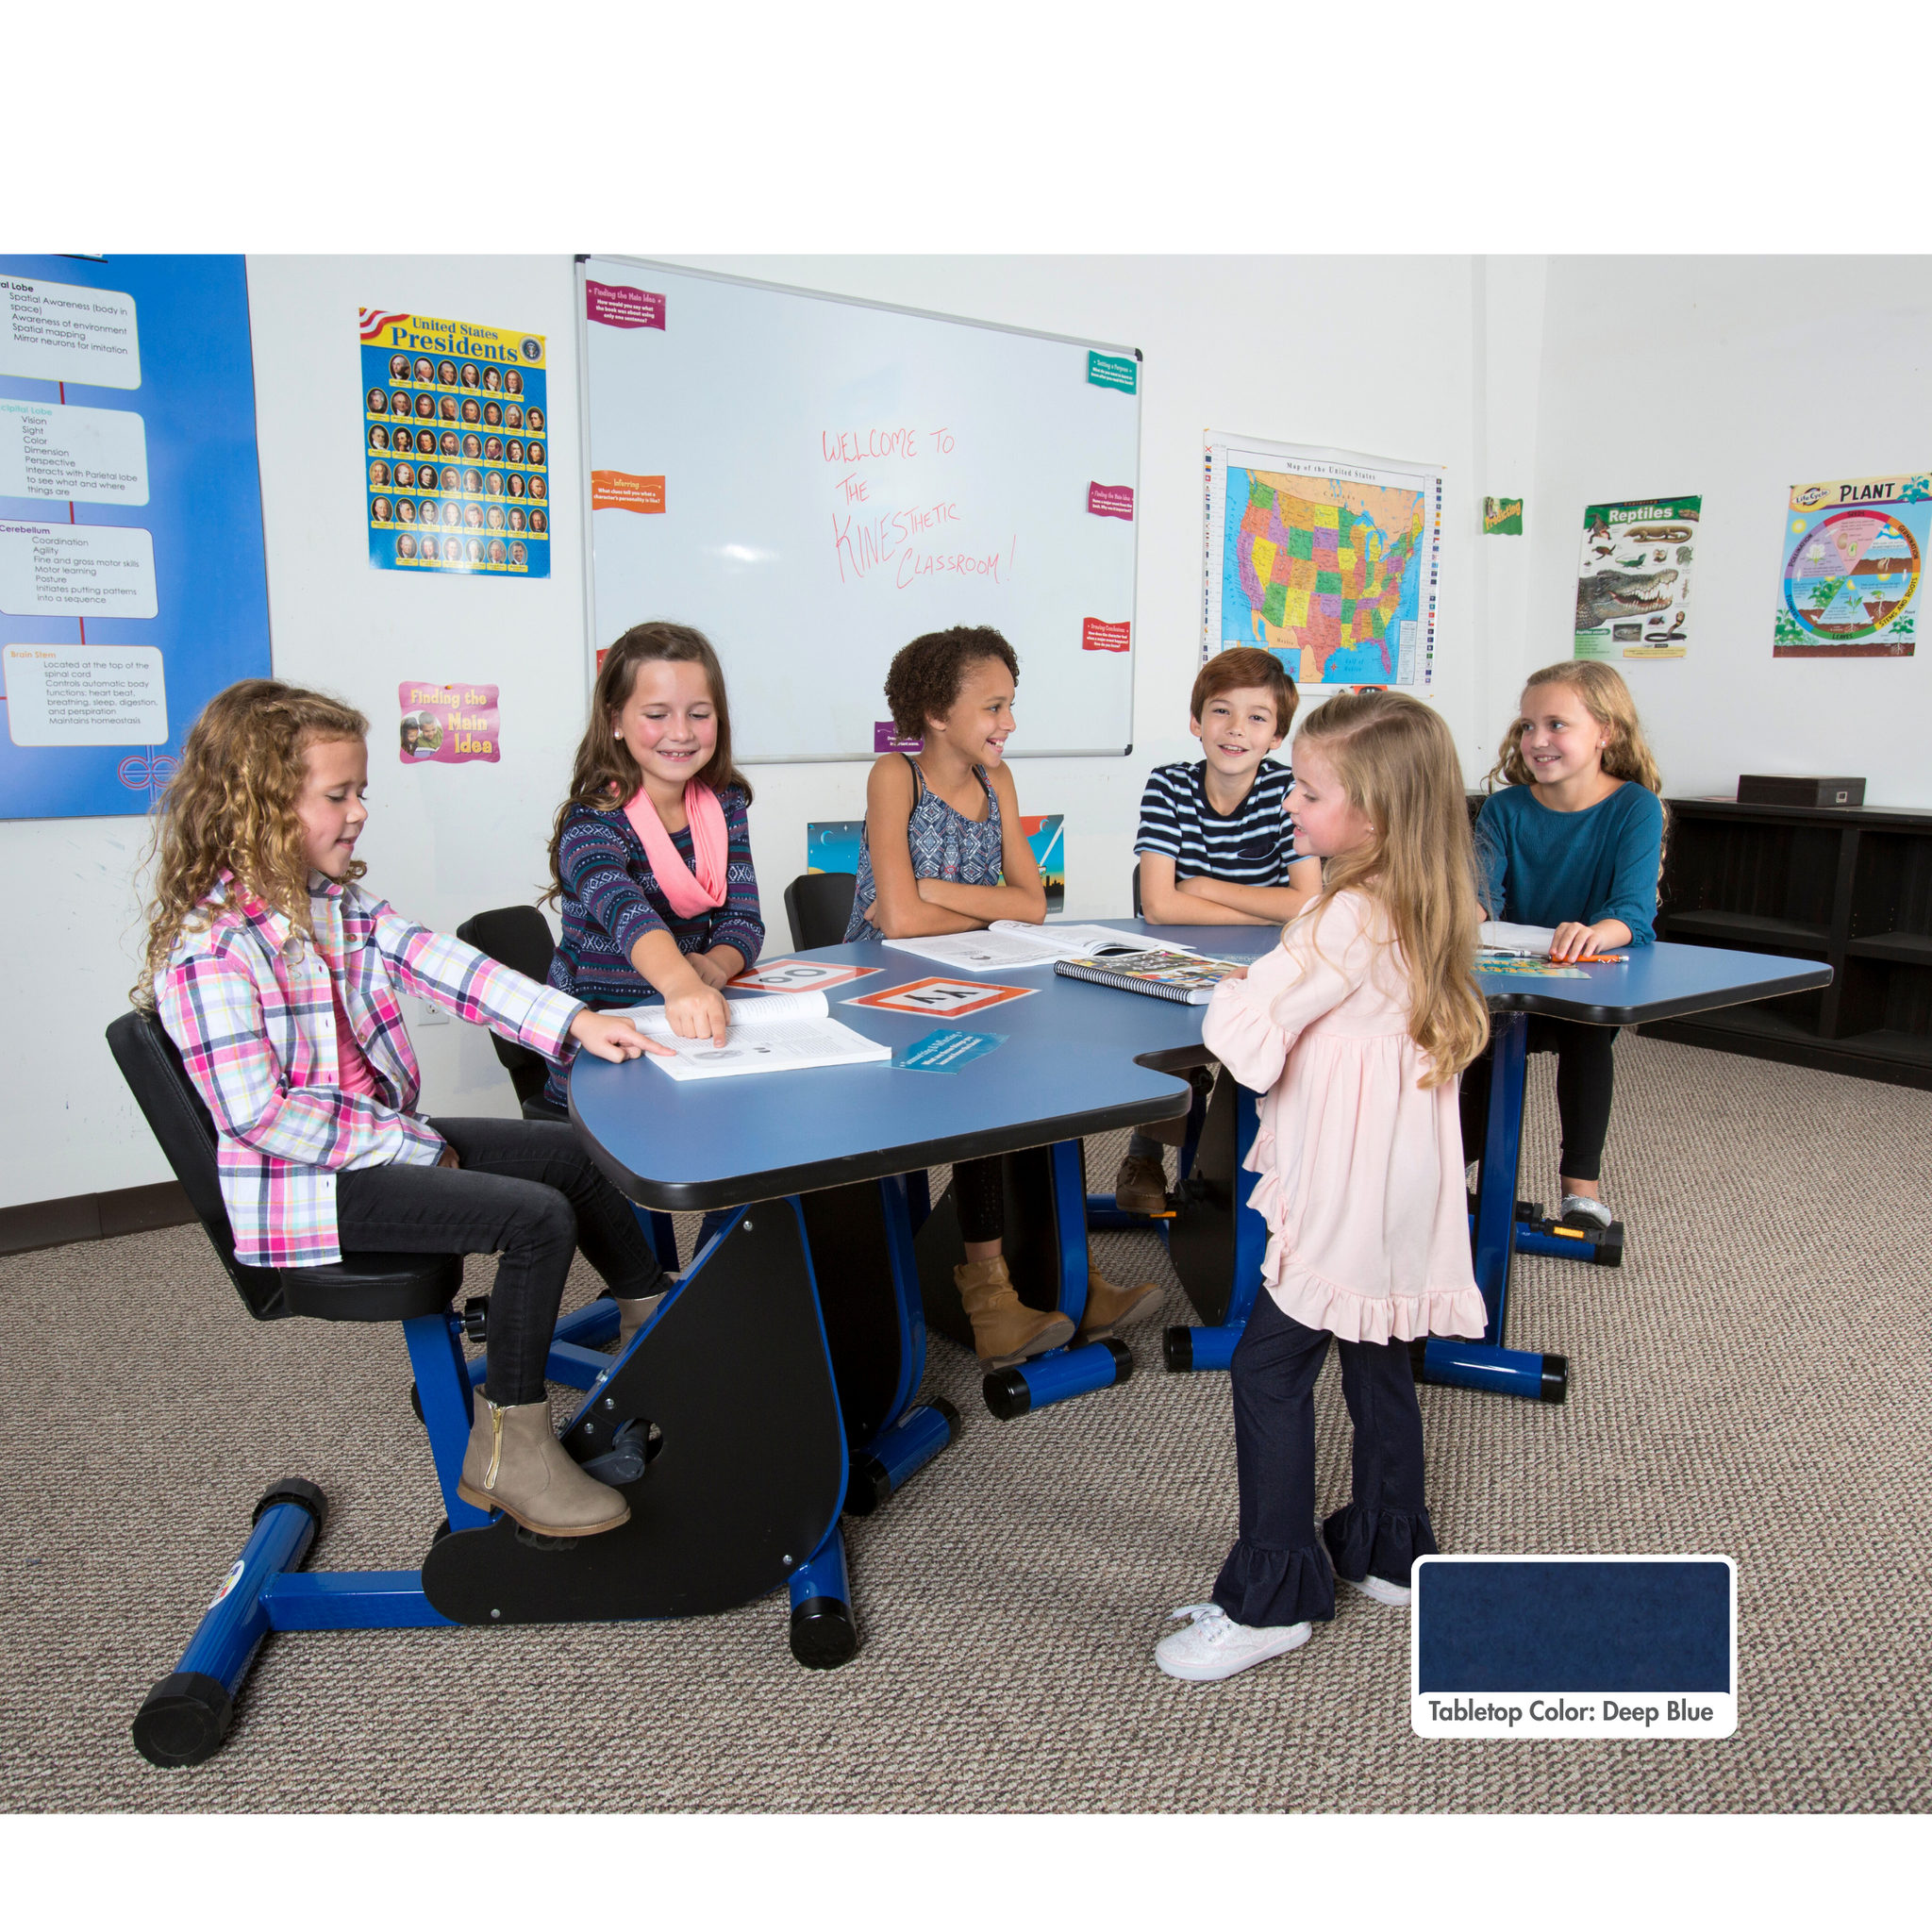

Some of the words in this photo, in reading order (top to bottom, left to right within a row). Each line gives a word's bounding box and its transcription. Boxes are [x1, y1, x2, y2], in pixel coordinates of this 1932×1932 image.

[12, 282, 33, 292] Lobe
[9, 292, 40, 304] Spatial
[43, 298, 90, 310] Awareness
[92, 304, 118, 315] (body
[594, 288, 616, 300] Finding
[643, 294, 656, 303] Idea
[10, 304, 42, 315] space)
[12, 313, 59, 325] Awareness
[74, 323, 126, 335] environment
[412, 317, 456, 333] United
[460, 324, 498, 340] States
[12, 324, 43, 334] Spatial
[46, 328, 85, 341] mapping
[14, 334, 38, 342] Mirror
[42, 338, 75, 348] neurons
[92, 343, 127, 354] imitation
[391, 326, 518, 362] Presidents
[31, 407, 52, 415] Lobe
[21, 416, 47, 425] Vision
[23, 426, 43, 435] Sight
[24, 436, 47, 444] Color
[824, 428, 917, 463] WELCOME
[930, 428, 954, 454] TO
[25, 446, 69, 457] Dimension
[25, 456, 75, 467] Perspective
[26, 466, 64, 475] Interacts
[86, 471, 117, 480] Parietal
[1287, 462, 1300, 471] Map
[1329, 467, 1351, 476] United
[1355, 471, 1375, 480] States
[27, 486, 53, 495] things
[614, 478, 639, 490] Inferring
[836, 473, 870, 506] THE
[1324, 491, 1355, 500] Canada
[1796, 494, 1809, 504] Life
[1810, 491, 1828, 499] Cycle
[1840, 483, 1895, 502] PLANT
[1485, 502, 1521, 530] Predicting
[1608, 507, 1673, 525] Reptiles
[0, 525, 50, 535] Cerebellum
[32, 537, 89, 546] Coordination
[832, 502, 960, 583] KINESTHETIC
[1898, 525, 1919, 559] GERMINATION
[33, 546, 58, 556] Agility
[1788, 534, 1813, 566] POLLINATION
[897, 534, 1016, 589] CLASSROOM!
[62, 567, 96, 576] learning
[72, 587, 101, 595] putting
[1879, 611, 1898, 626] STEMS
[1898, 599, 1907, 610] AND
[1905, 577, 1918, 597] ROOTS
[127, 680, 149, 689] body
[410, 688, 460, 709] Finding
[465, 689, 487, 705] the
[448, 712, 487, 731] Main
[455, 733, 492, 754] Idea
